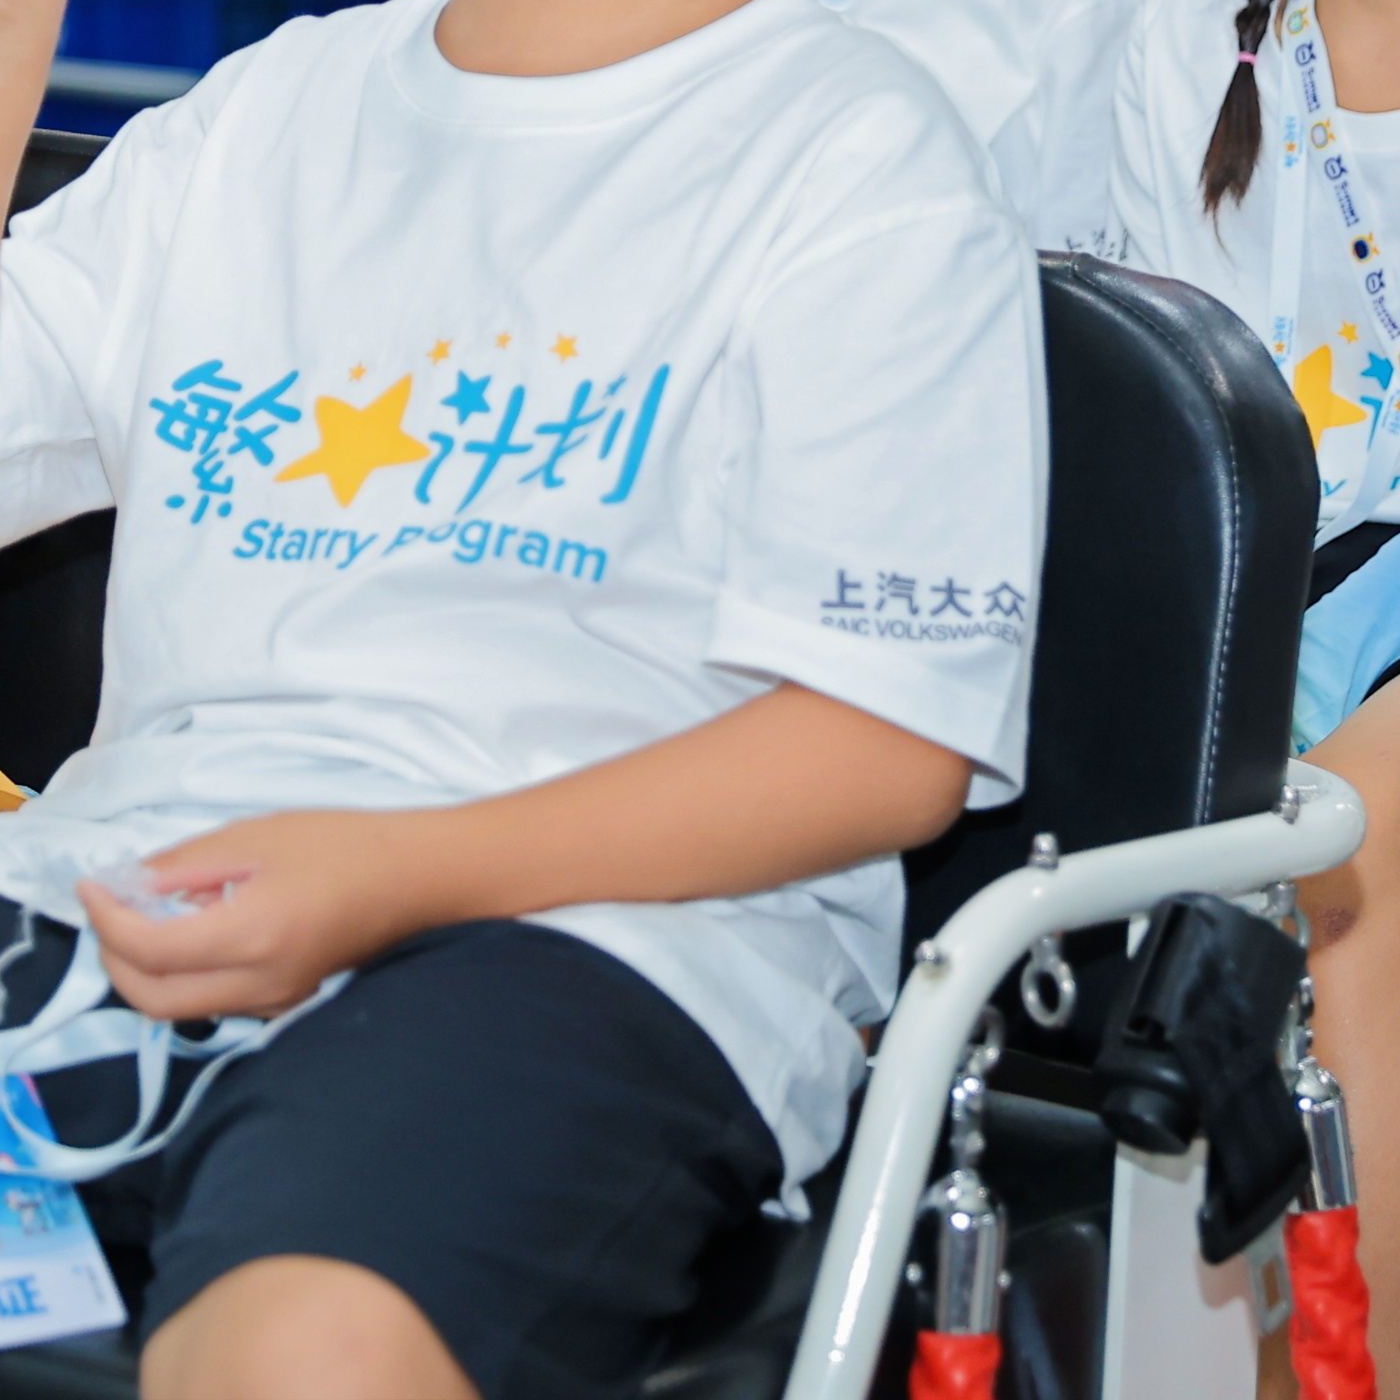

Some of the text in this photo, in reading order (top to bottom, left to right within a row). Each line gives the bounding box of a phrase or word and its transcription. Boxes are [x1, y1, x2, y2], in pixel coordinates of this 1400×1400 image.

[232, 518, 379, 570] Starry
[820, 568, 1026, 622] 上汽大众
[875, 619, 1025, 648] VOLKSWAGEN
